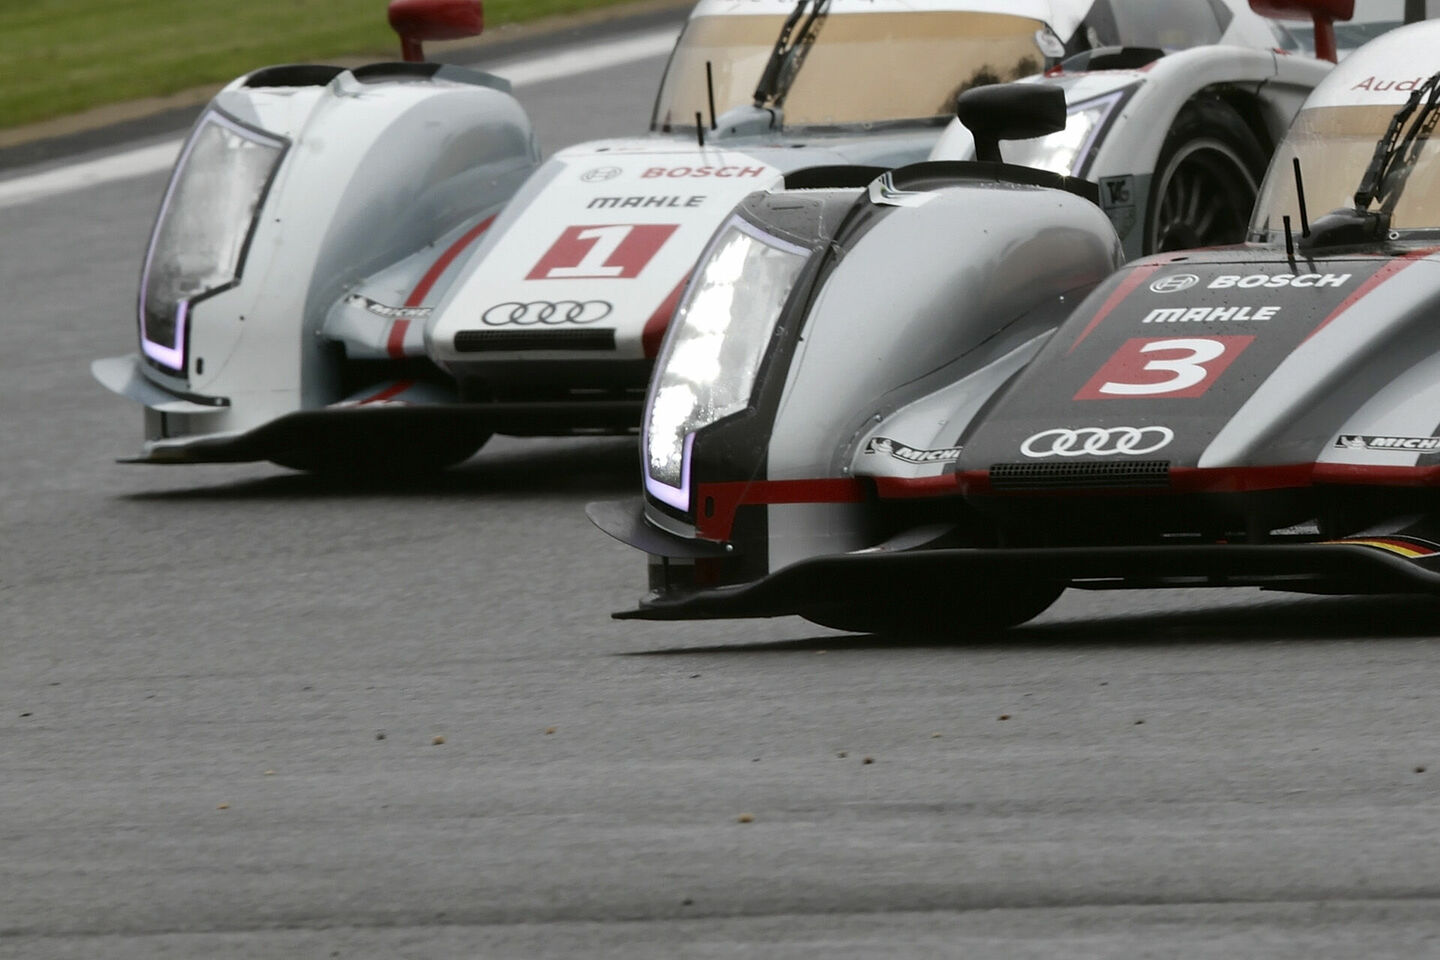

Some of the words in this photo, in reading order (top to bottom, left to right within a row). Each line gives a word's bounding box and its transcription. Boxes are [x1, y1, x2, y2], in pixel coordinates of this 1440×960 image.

[1351, 76, 1424, 91] Aud
[640, 166, 766, 179] BOSCH
[586, 196, 707, 209] MAHLE
[546, 224, 635, 278] 1
[1207, 273, 1352, 289] BOSCH
[1142, 305, 1282, 323] MAHLE
[1099, 338, 1226, 395] 3
